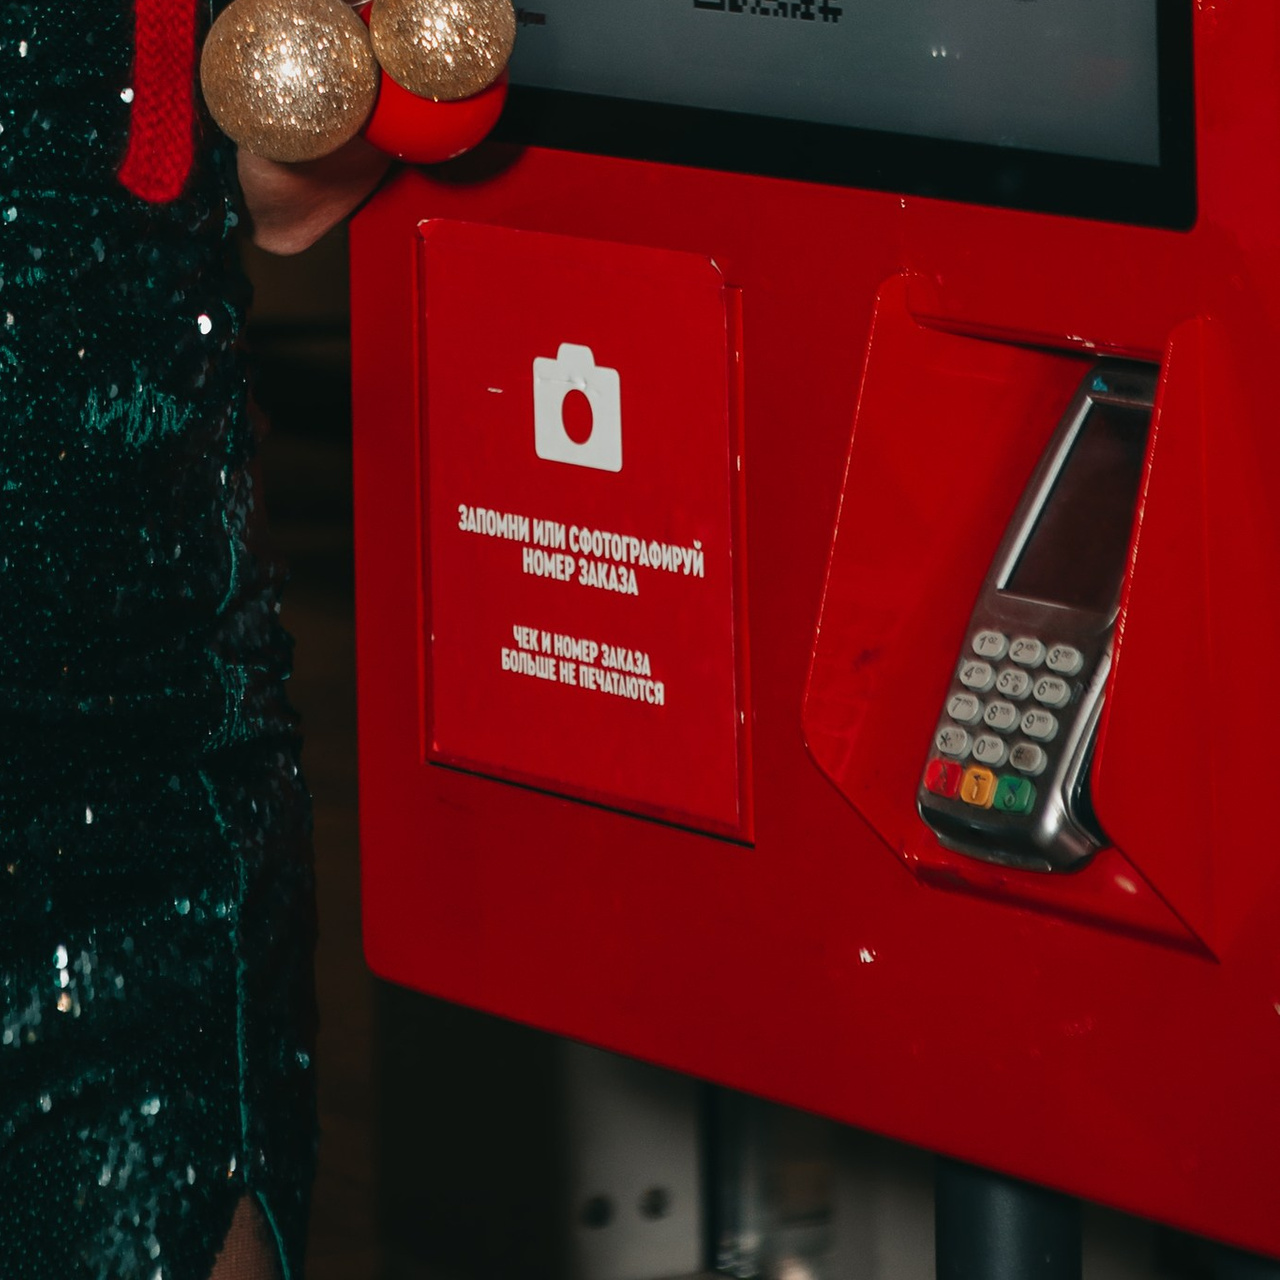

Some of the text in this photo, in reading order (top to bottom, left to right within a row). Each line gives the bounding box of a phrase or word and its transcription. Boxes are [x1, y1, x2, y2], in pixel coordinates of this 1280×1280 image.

[458, 503, 705, 579] ЗАПОМНИ ИЛИ СФОТОГРАФИРУЙ
[523, 547, 639, 596] НОМЕР ЗАКАЗА
[513, 625, 651, 677] ЧЕК И НОМЕР ЗАКАЗА
[1013, 642, 1024, 657] 2
[501, 647, 665, 707] БОЛЬШЕ НЕ ПЕЧАТАЮТСЯ
[964, 666, 974, 681] 4
[1000, 673, 1011, 688] 5
[1037, 681, 1048, 696] 6
[952, 697, 963, 712] 7
[988, 705, 998, 721] 8
[1024, 713, 1035, 729] 9
[976, 739, 986, 755] 0
